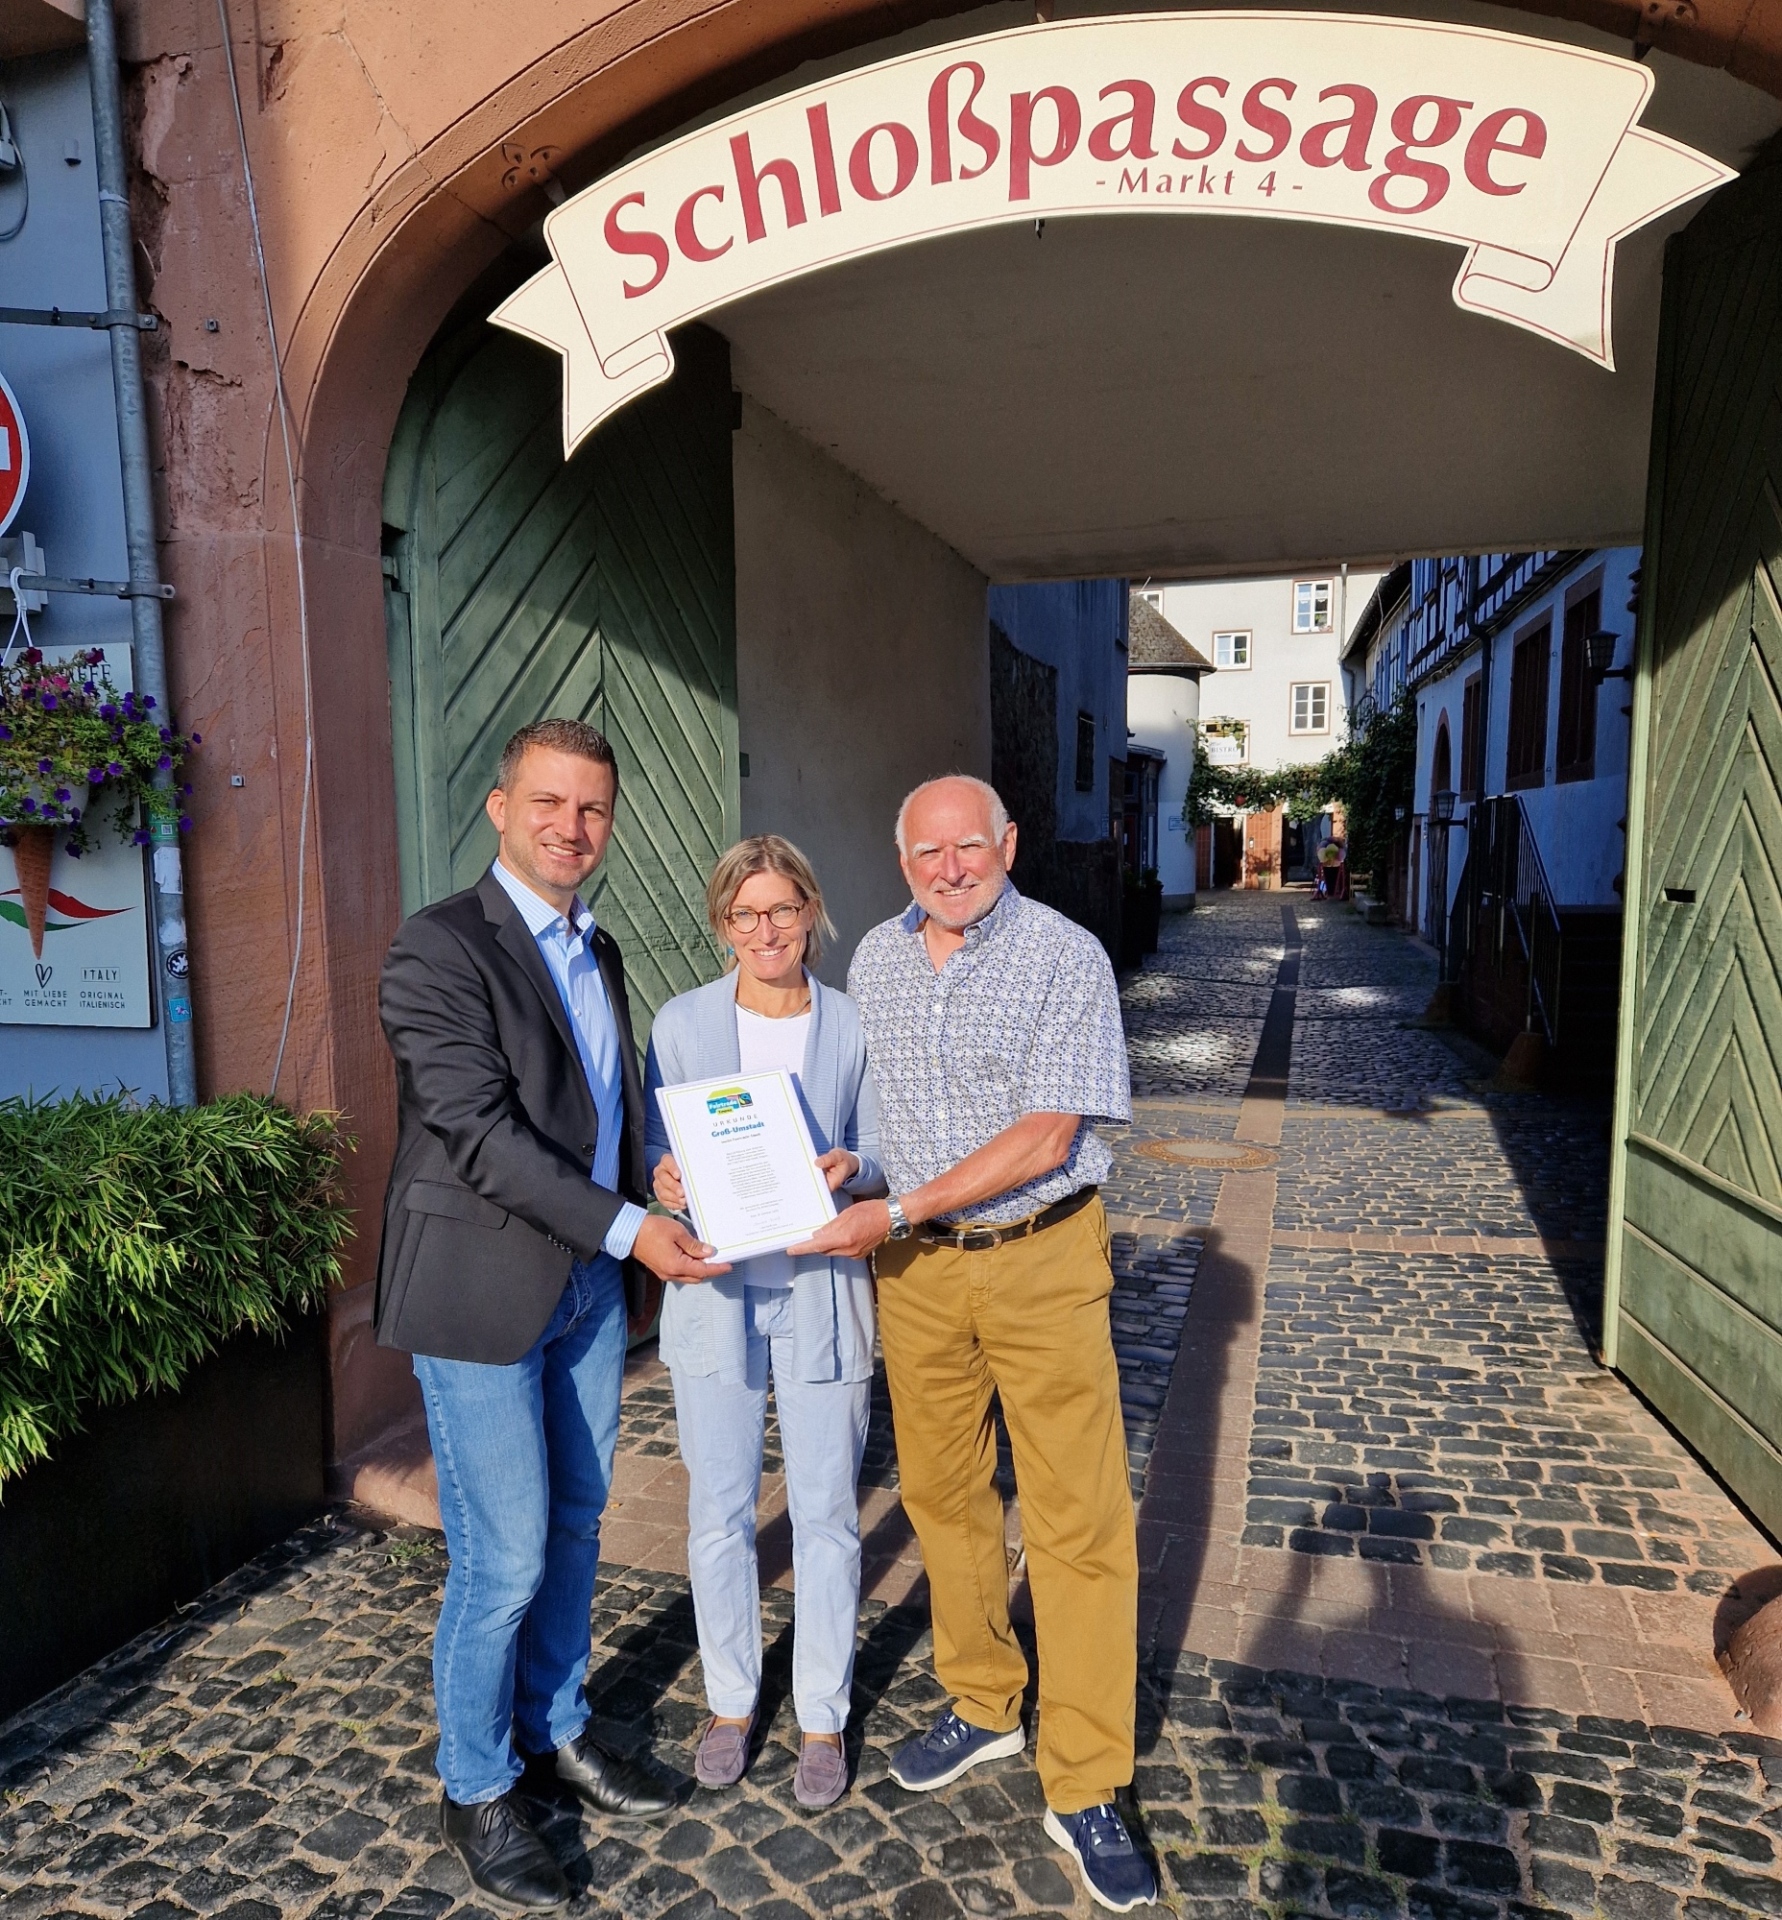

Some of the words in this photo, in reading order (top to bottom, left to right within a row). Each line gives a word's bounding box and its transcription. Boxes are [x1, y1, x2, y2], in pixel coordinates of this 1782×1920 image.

[603, 60, 1548, 300] Schloßpassage
[83, 969, 118, 981] ITALY
[23, 989, 39, 998] MIT
[43, 990, 68, 999] LIEBE
[79, 991, 124, 1000] ORIGINAL
[24, 999, 67, 1007] GEMACHT
[79, 1000, 126, 1009] ITALIENISCH
[712, 1113, 758, 1127] URKUNDE
[711, 1121, 765, 1138] Groß-Umstadt
